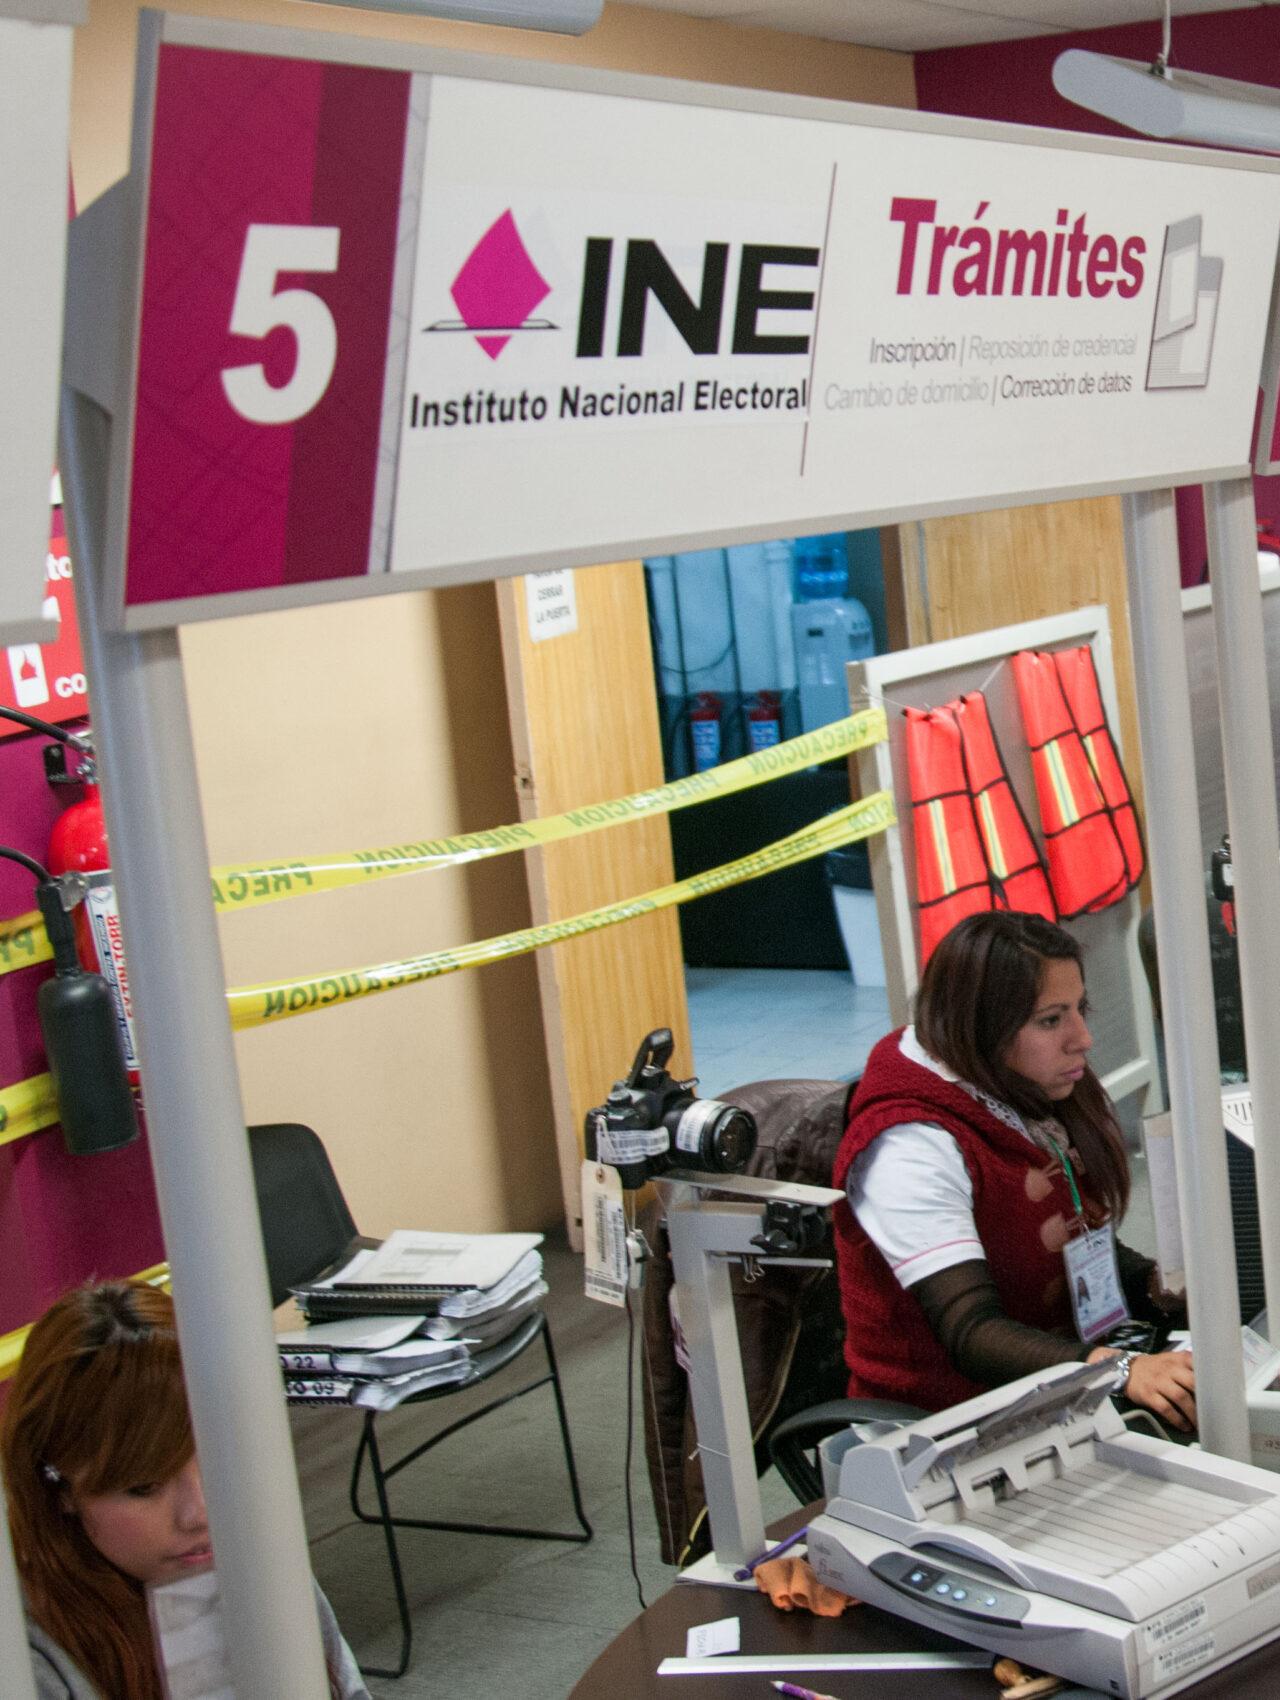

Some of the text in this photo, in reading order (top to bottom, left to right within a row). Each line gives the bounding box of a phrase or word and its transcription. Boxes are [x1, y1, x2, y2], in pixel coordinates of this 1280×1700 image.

[890, 196, 1147, 299] Trámites
[575, 237, 820, 358] INE
[221, 224, 341, 424] 5
[869, 334, 1137, 368] Inscripción Reposición de credencial
[411, 377, 807, 428] Instituto Nacional Electoral
[823, 370, 1133, 410] Cambio de domicilio Corrección de datos
[293, 1355, 317, 1369] 22
